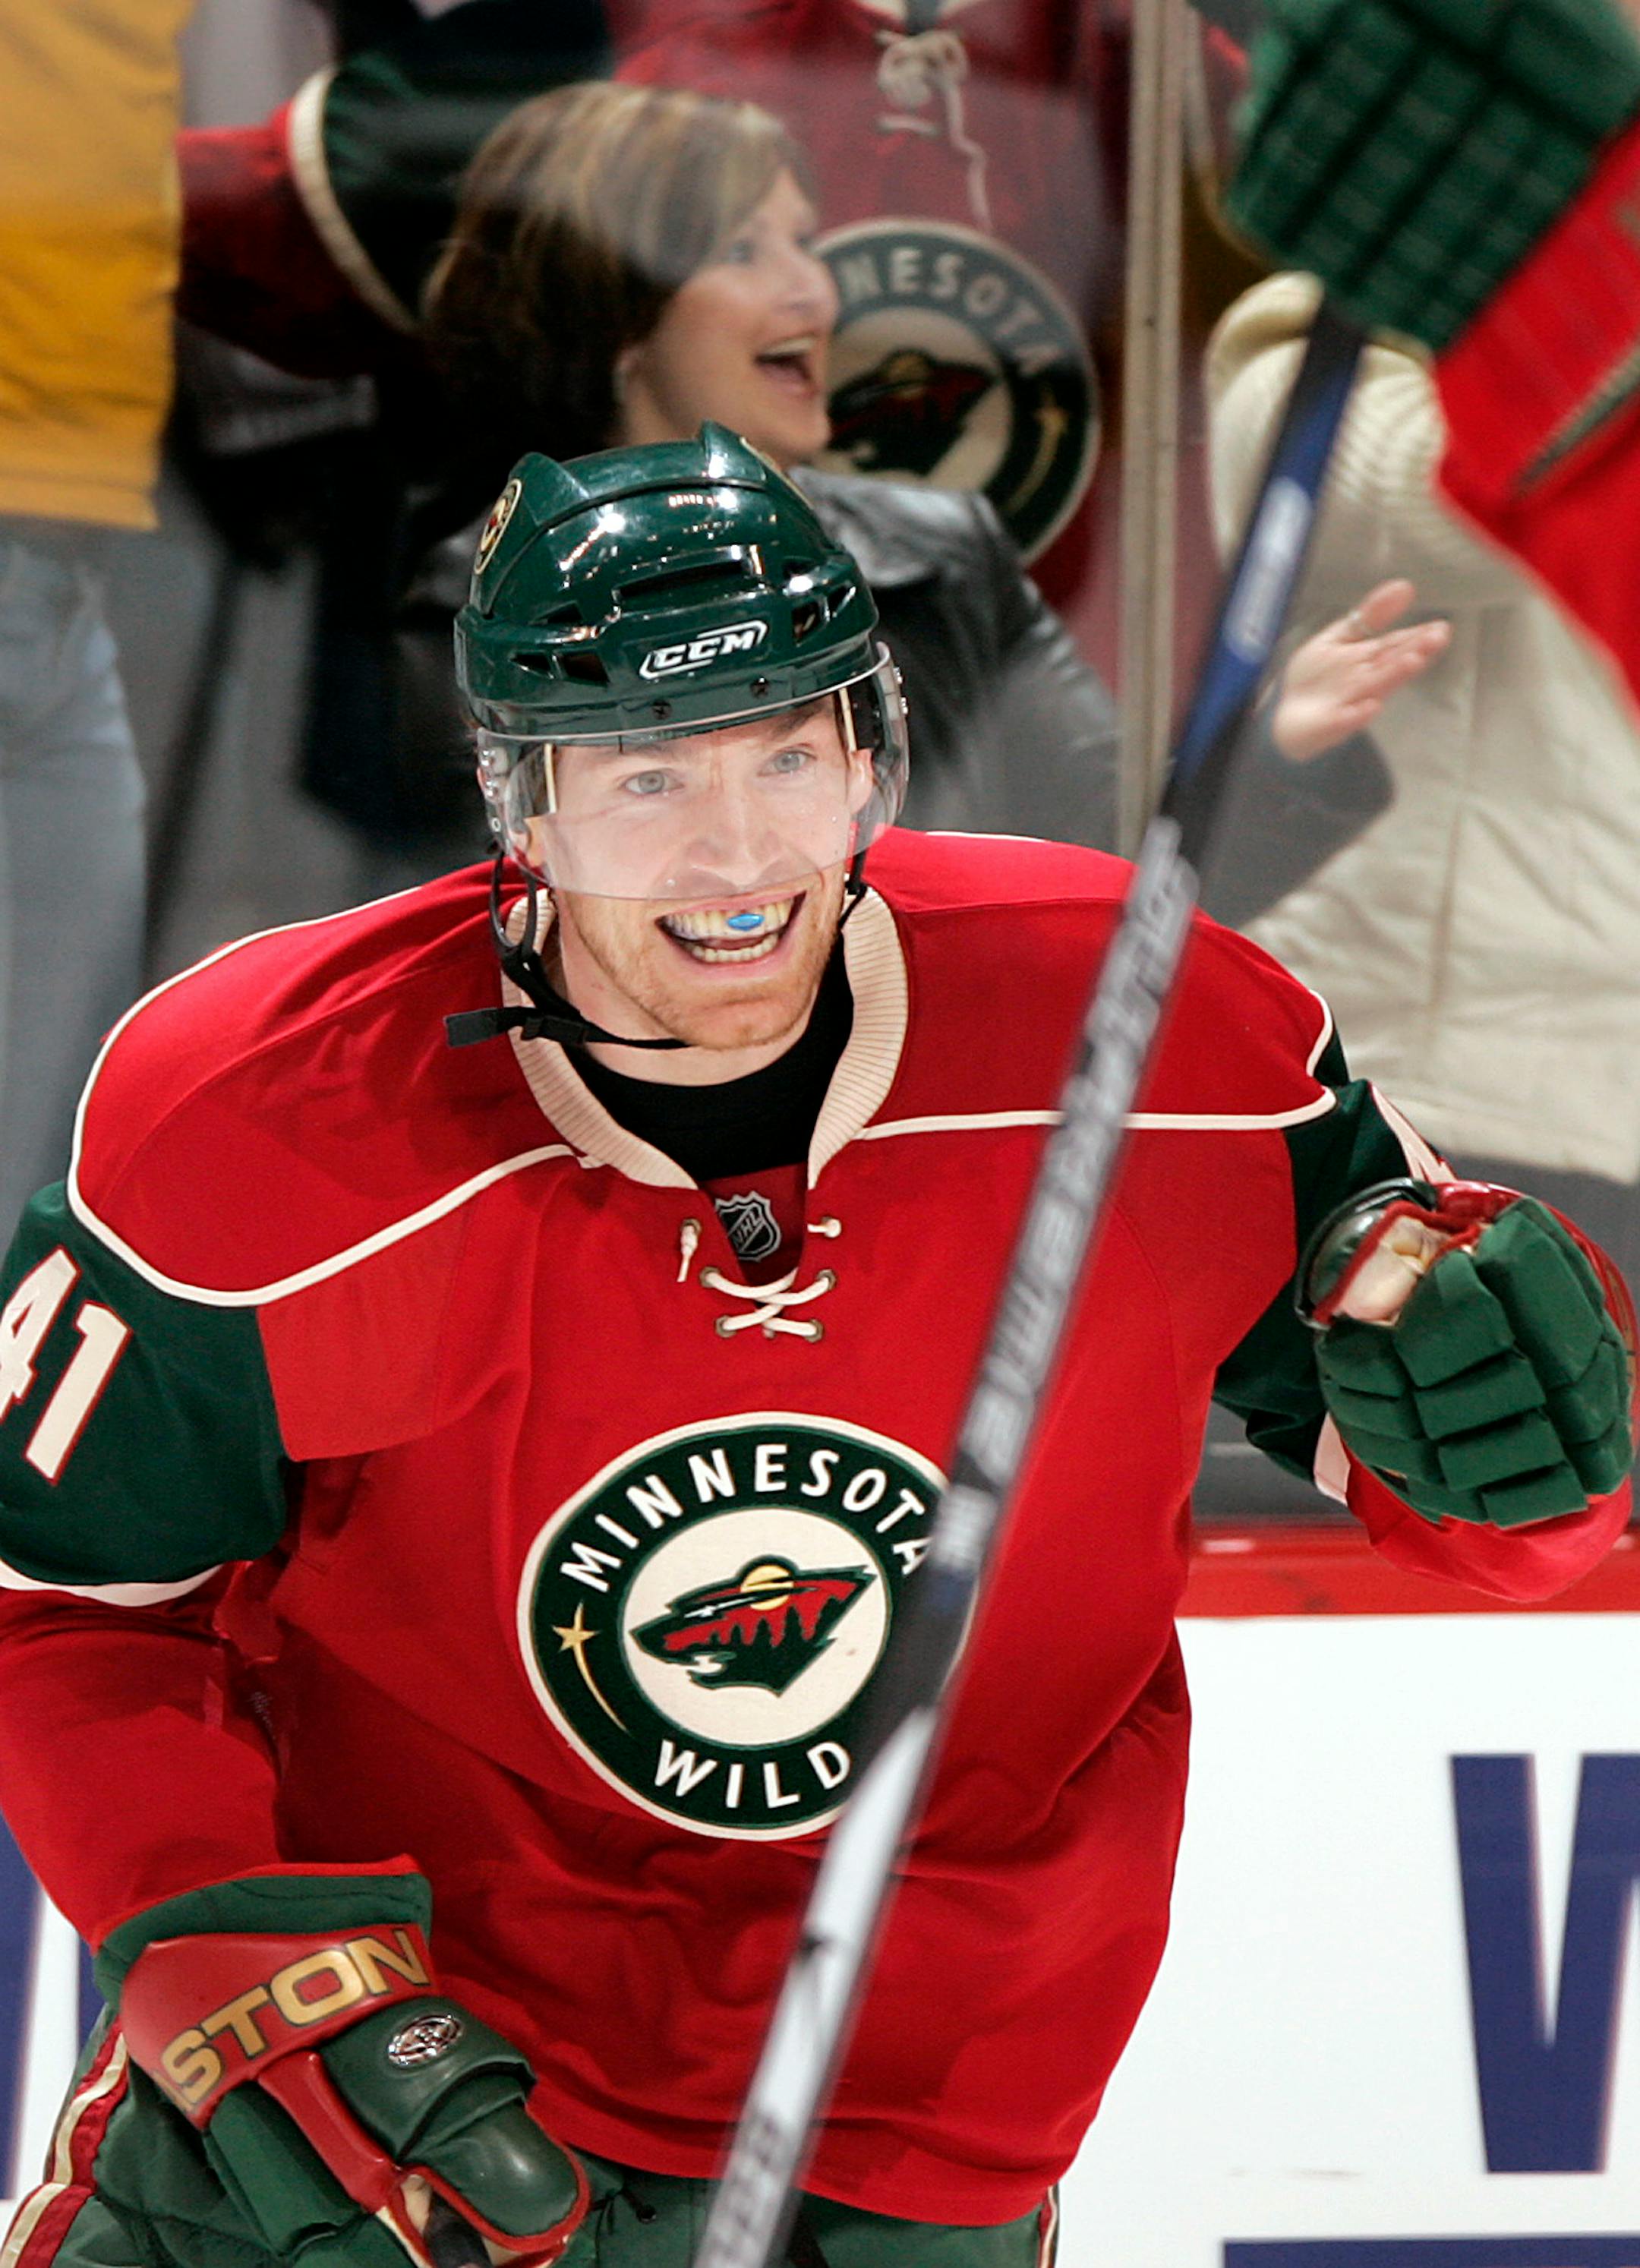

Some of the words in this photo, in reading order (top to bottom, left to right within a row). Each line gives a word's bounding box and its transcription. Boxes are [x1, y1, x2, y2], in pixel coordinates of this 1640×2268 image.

[653, 629, 757, 670] CCM
[0, 1245, 134, 1484] 41
[560, 1443, 934, 1594] MINNESOTA
[654, 1740, 850, 1809] WILD
[152, 1929, 430, 2114] STON
